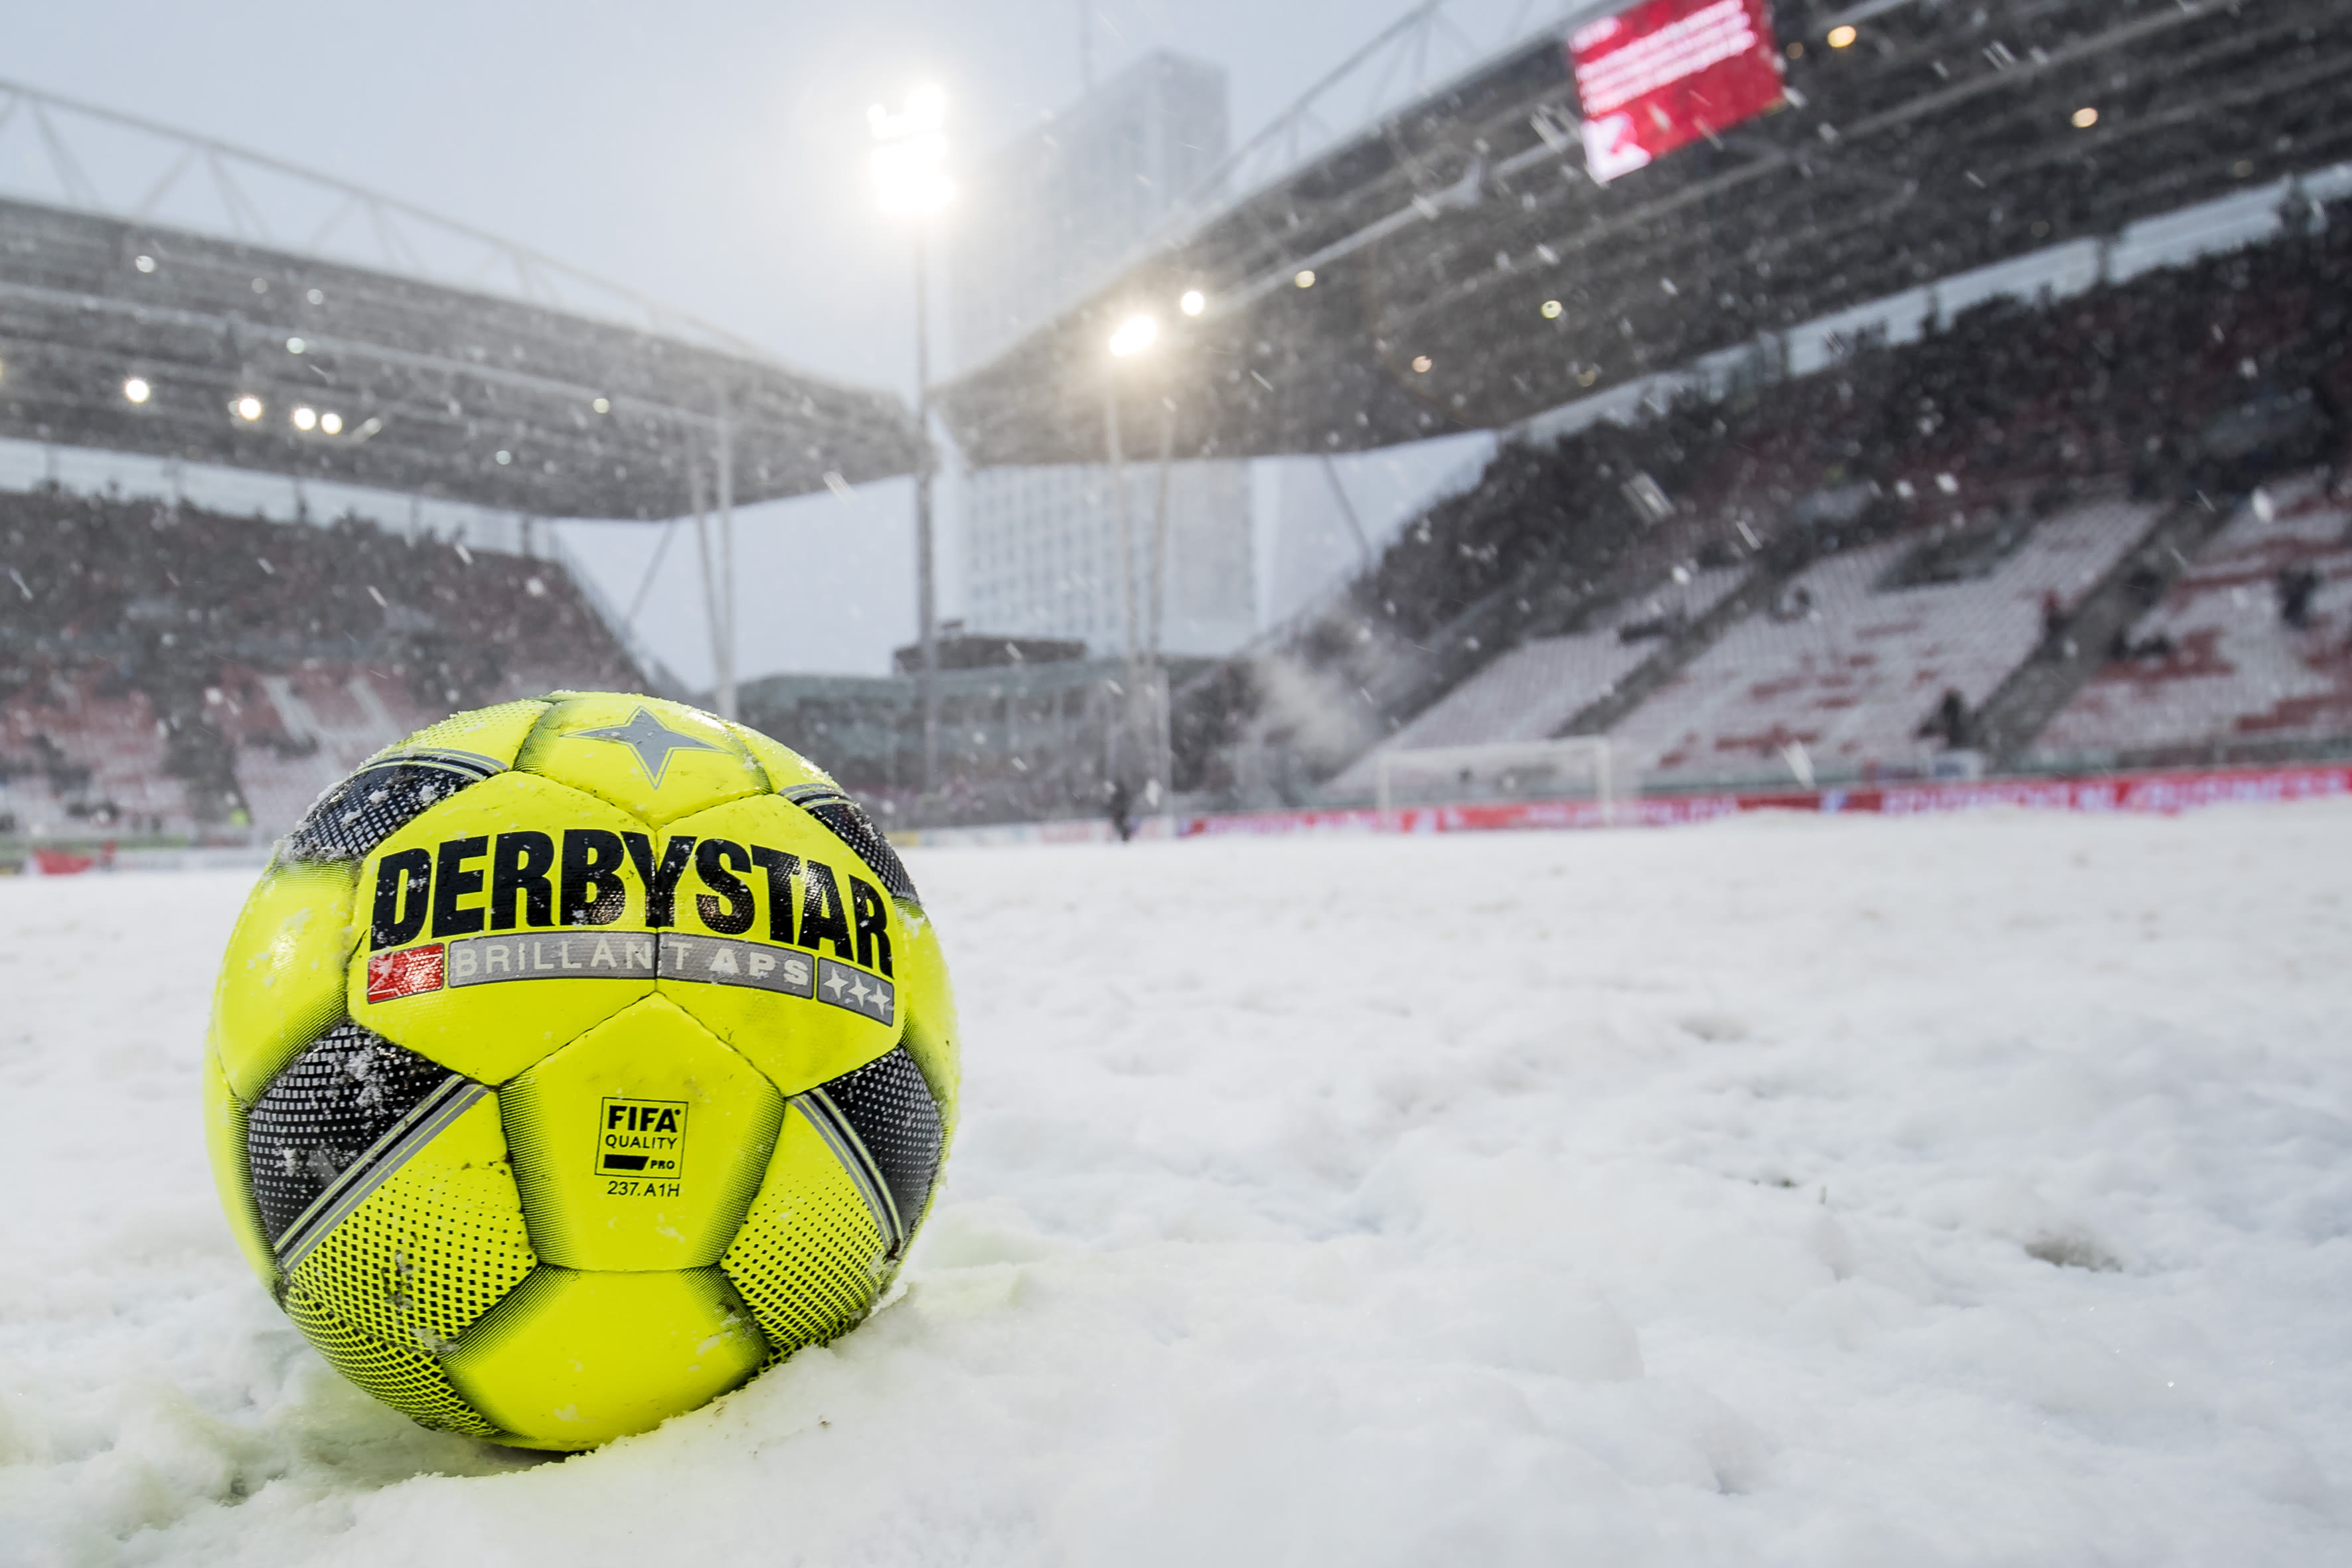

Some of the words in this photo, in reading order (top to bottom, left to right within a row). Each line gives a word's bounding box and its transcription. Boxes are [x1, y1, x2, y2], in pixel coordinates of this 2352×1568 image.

[370, 829, 894, 979] DERBYSTAR
[455, 941, 693, 978] BRILLANT
[708, 947, 808, 986] APS
[608, 1105, 678, 1133] FIFA
[605, 1134, 678, 1149] QUALITY
[650, 1160, 675, 1170] PRO
